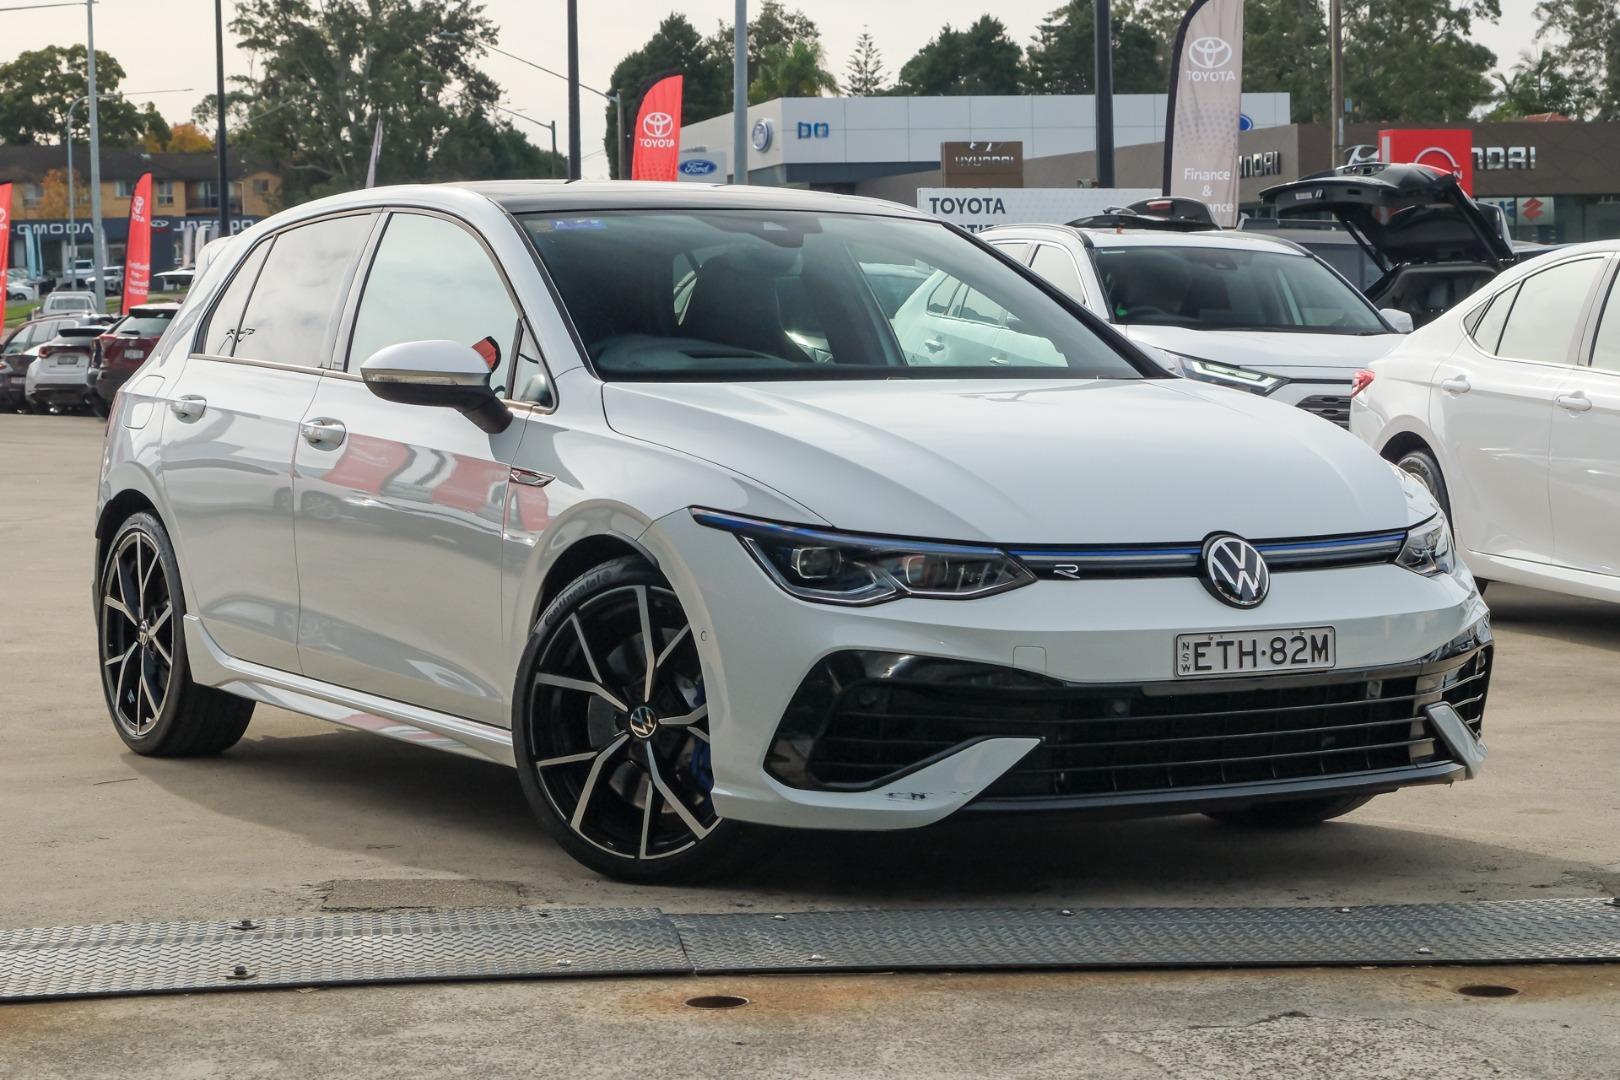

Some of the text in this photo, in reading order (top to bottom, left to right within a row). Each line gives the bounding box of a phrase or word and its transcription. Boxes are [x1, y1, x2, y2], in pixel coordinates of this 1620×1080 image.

[1186, 71, 1236, 82] TOYOTA
[639, 138, 675, 148] TOYOTA
[1184, 168, 1231, 180] Finance
[1202, 185, 1212, 197] &
[928, 197, 1006, 214] TOYOTA
